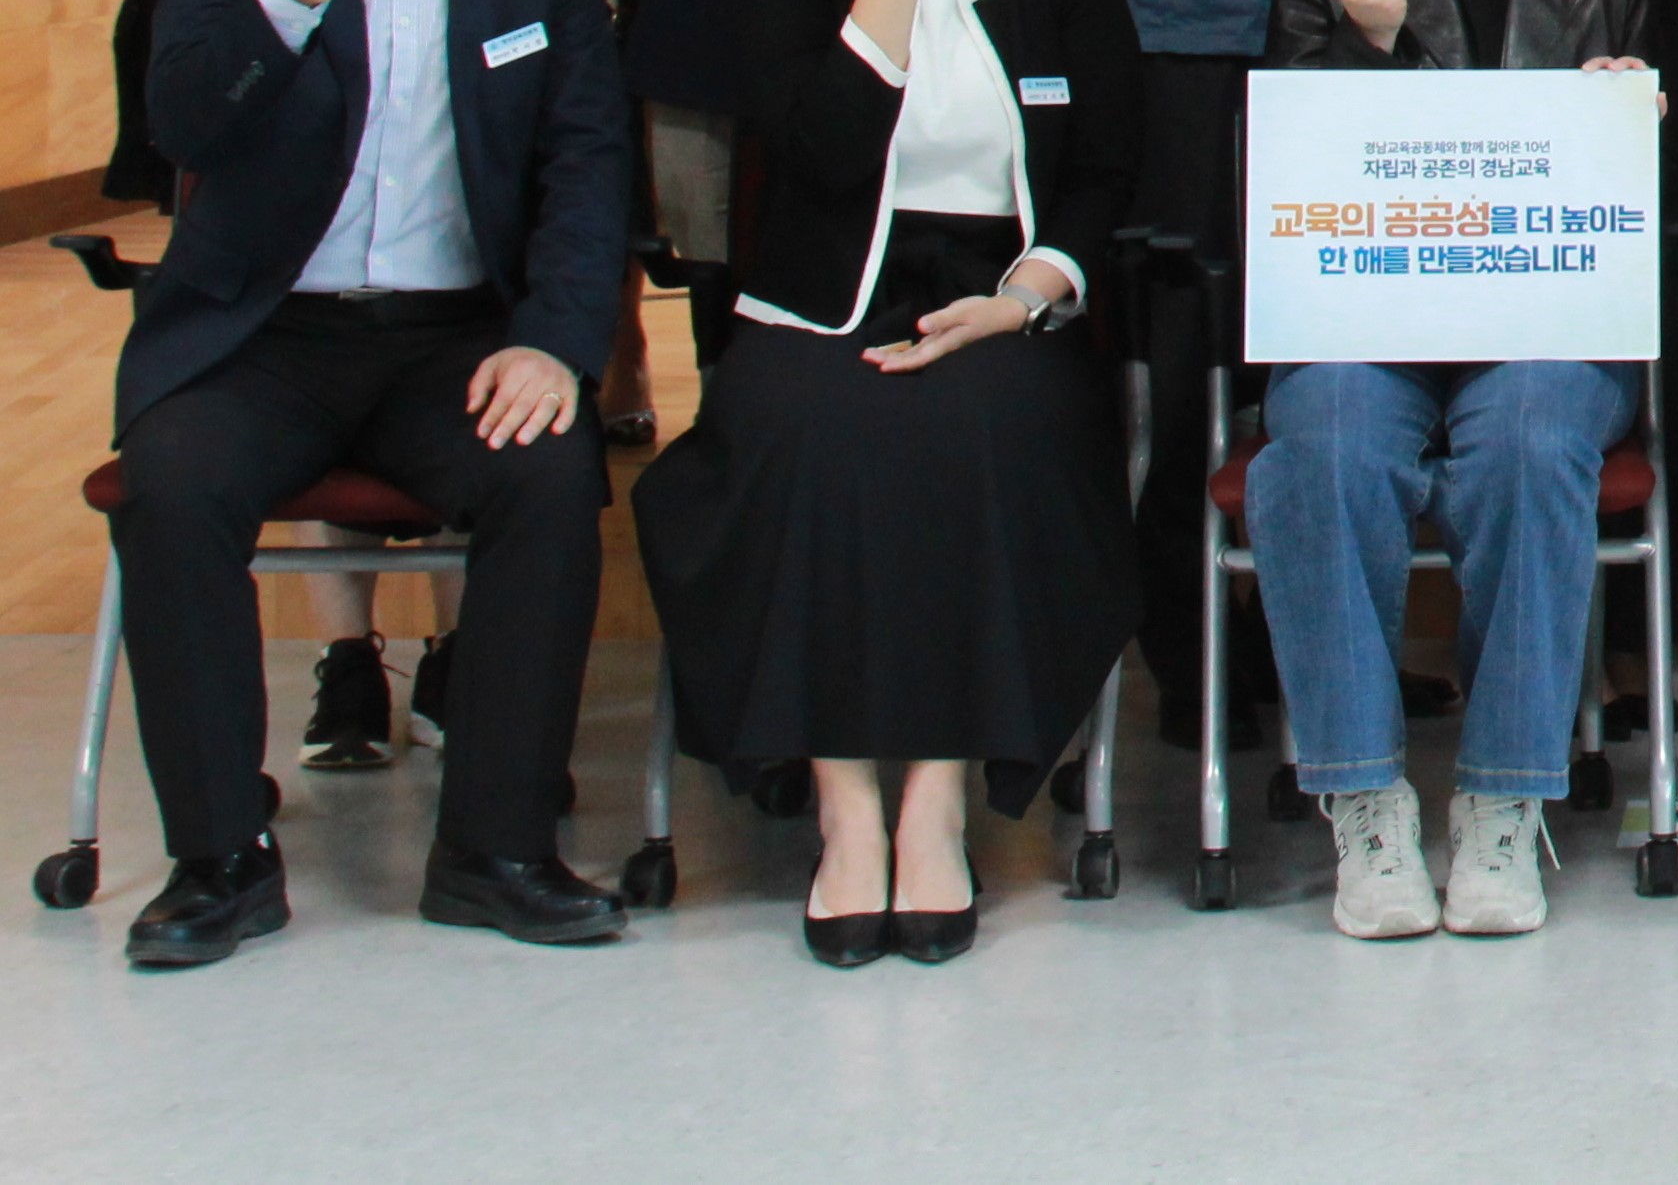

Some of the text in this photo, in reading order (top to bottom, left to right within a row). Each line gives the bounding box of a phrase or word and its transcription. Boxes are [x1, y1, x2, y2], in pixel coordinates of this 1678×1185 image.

[1364, 140, 1551, 155] 경남교육공동체와 함께 걸어온 10년
[1363, 157, 1552, 179] 자립과 공존의 경남교육
[1269, 200, 1645, 238] 교육의 공공성을 더 높이는
[1318, 244, 1597, 275] 한 해를 만들겠습니다!
